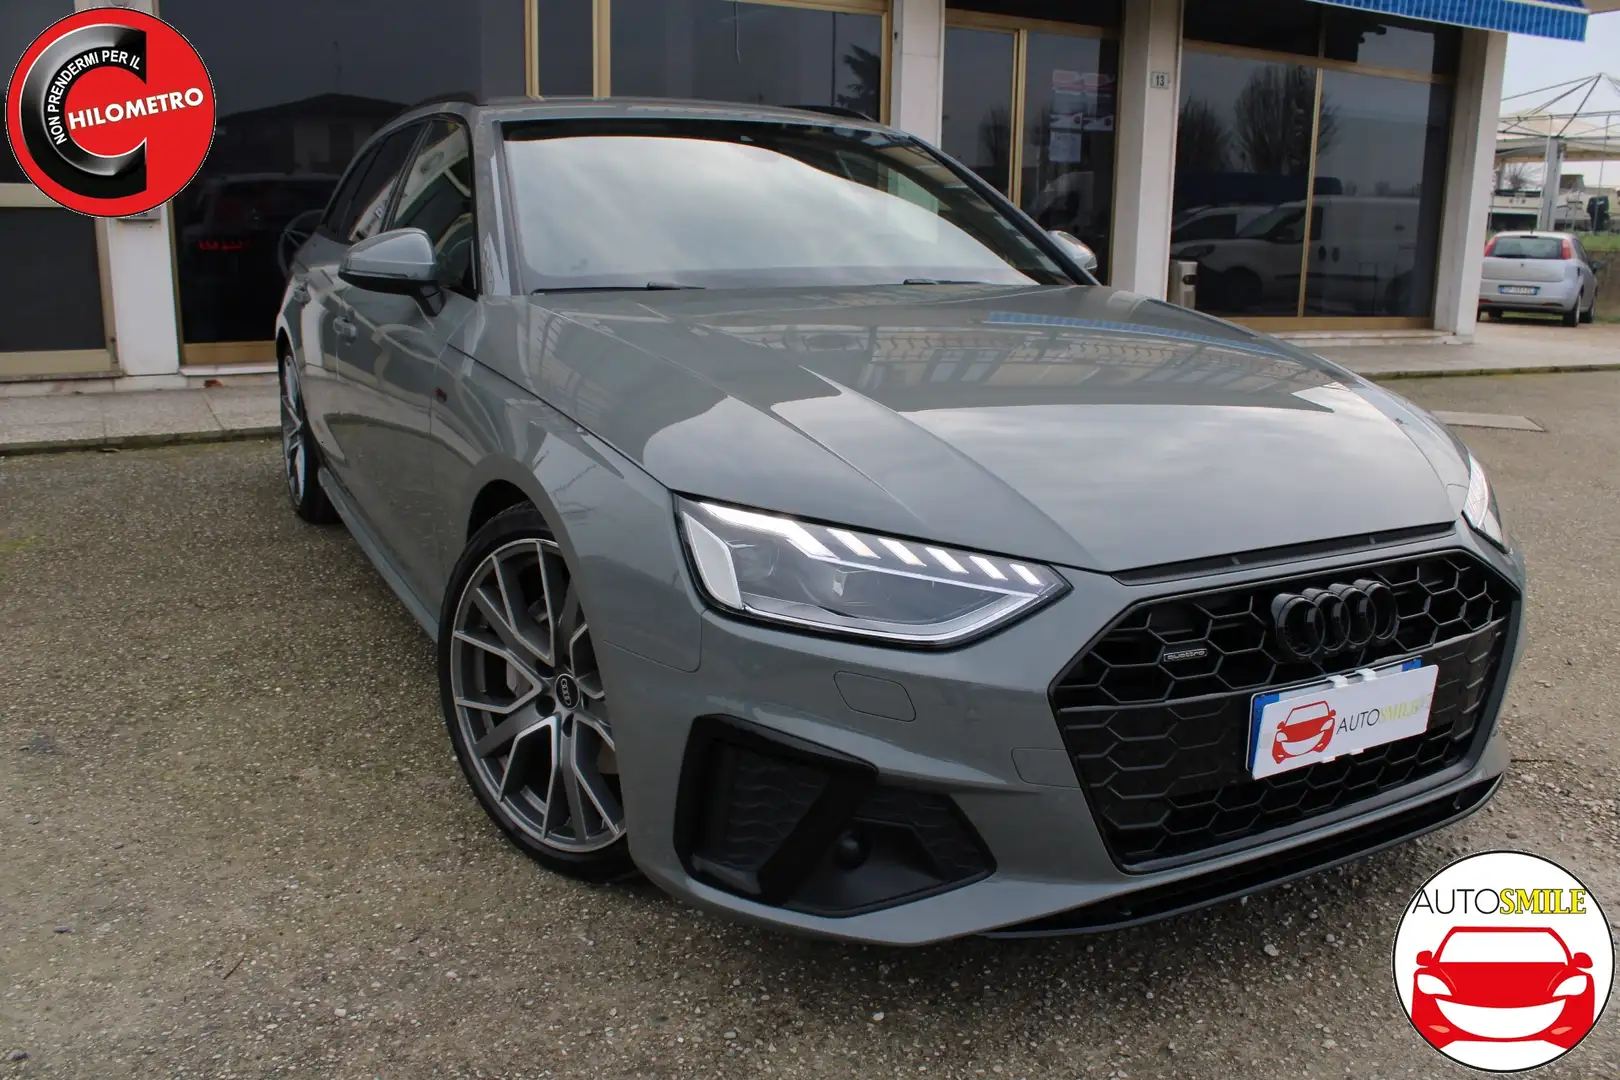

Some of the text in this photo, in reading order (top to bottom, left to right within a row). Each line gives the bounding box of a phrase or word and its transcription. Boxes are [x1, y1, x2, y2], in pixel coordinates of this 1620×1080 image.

[1156, 74, 1165, 87] 13
[1166, 649, 1206, 661] quattro
[1336, 699, 1419, 735] AUTOSMILE
